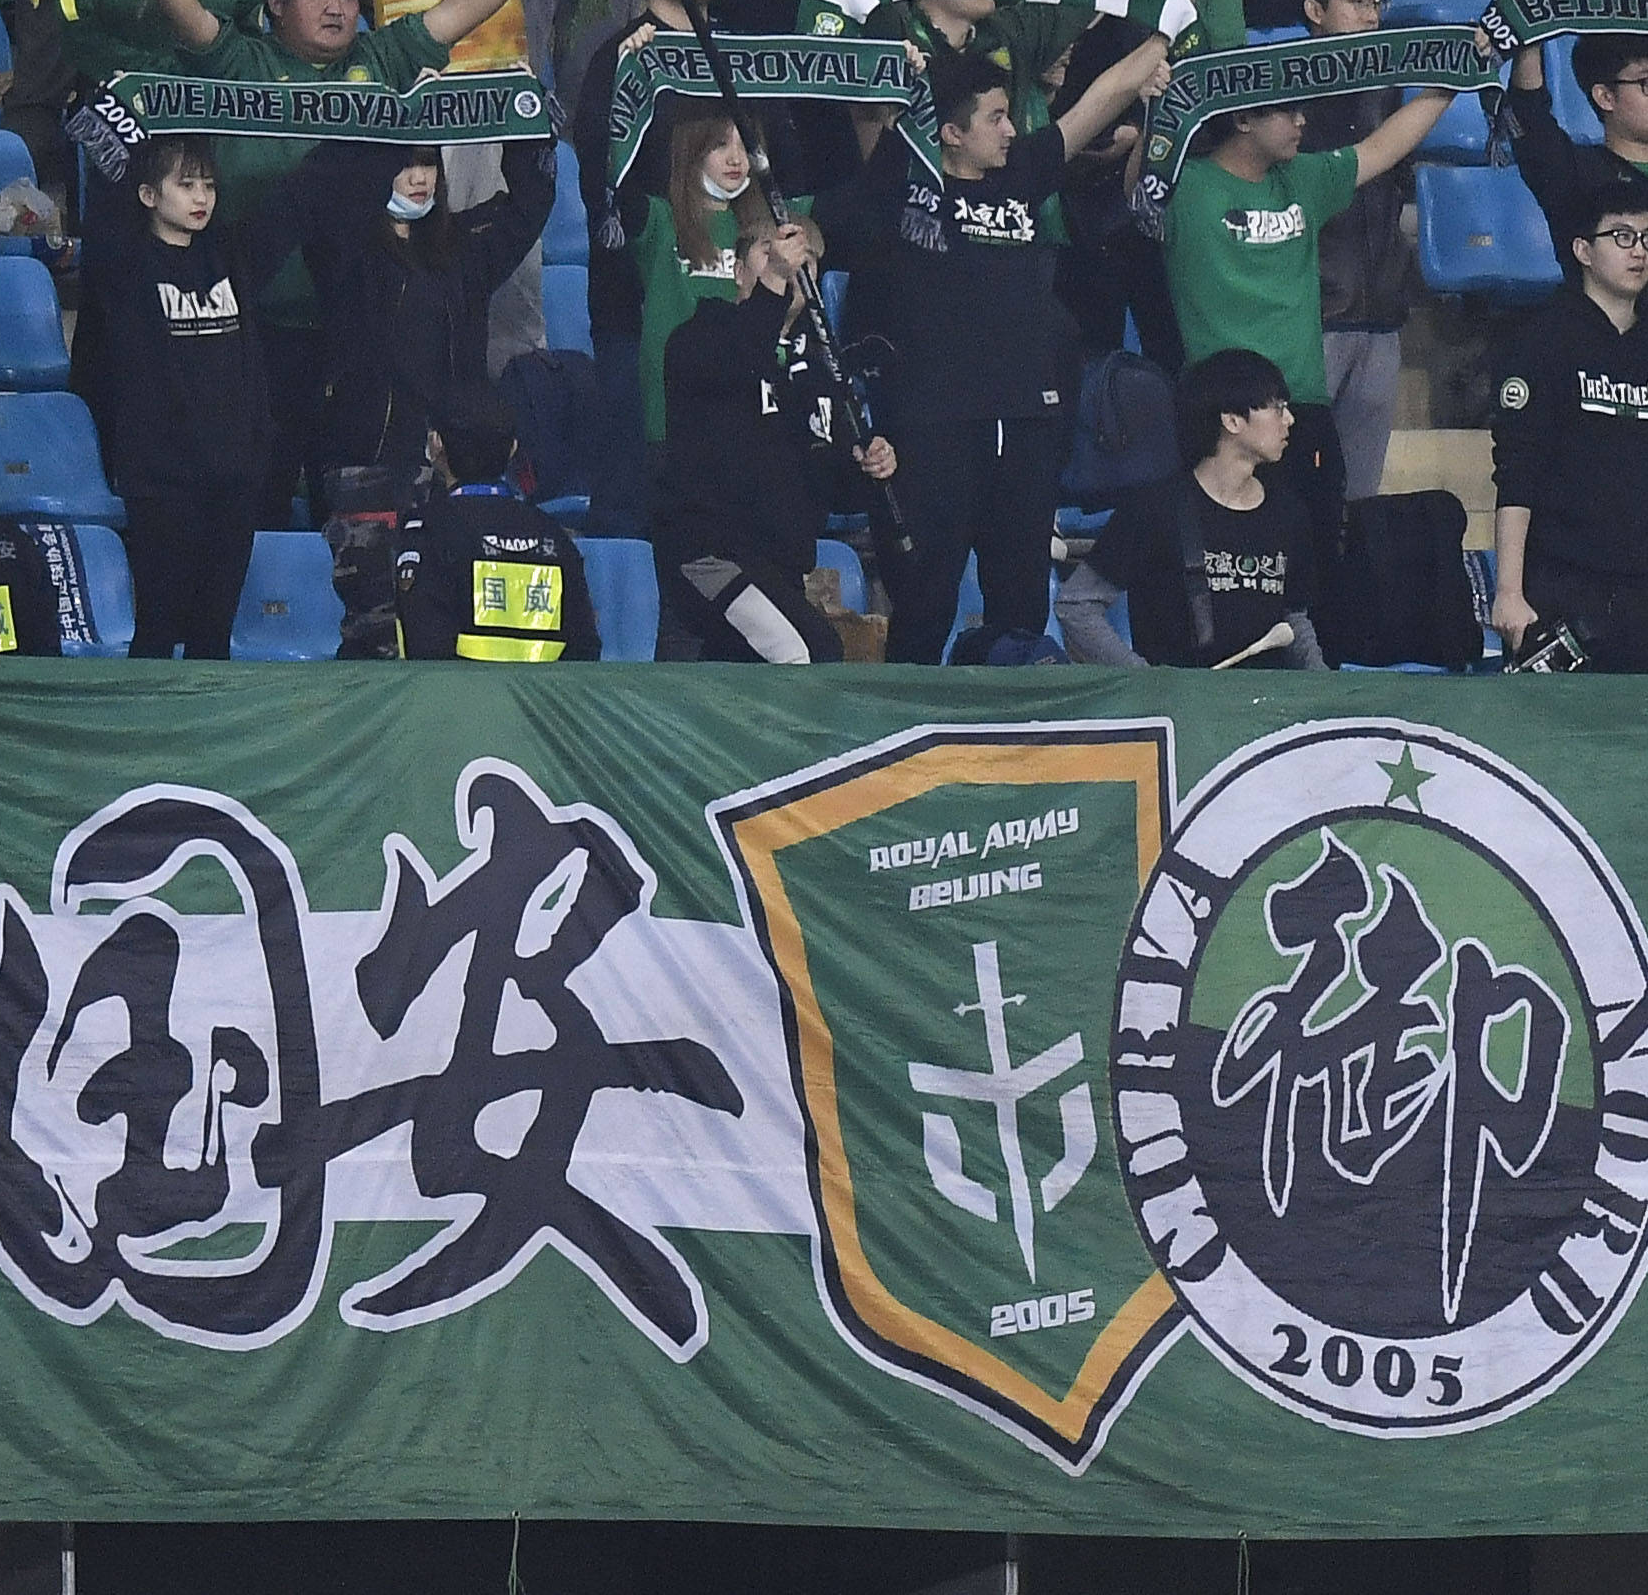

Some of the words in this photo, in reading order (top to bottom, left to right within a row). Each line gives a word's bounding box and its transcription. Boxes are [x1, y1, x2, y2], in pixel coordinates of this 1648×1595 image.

[1481, 6, 1519, 51] 2005
[637, 46, 716, 82] ARE
[728, 48, 867, 87] ROYAL
[1154, 72, 1203, 133] WE
[1203, 60, 1274, 101] ARE
[1278, 44, 1395, 90] ROYAL
[1398, 39, 1493, 76] ARMY
[95, 94, 146, 144] 2005
[141, 82, 207, 118] WE
[211, 86, 284, 123] ARE
[290, 90, 412, 131] ROYAL
[414, 88, 513, 130] ARMY
[482, 576, 554, 614] 国威
[869, 831, 977, 873] ROYAL
[980, 807, 1080, 860] ARMY
[909, 862, 1043, 912] BEIJING
[1212, 825, 1572, 1324] 御
[988, 1287, 1096, 1338] 2005
[1268, 1322, 1468, 1407] 2005
